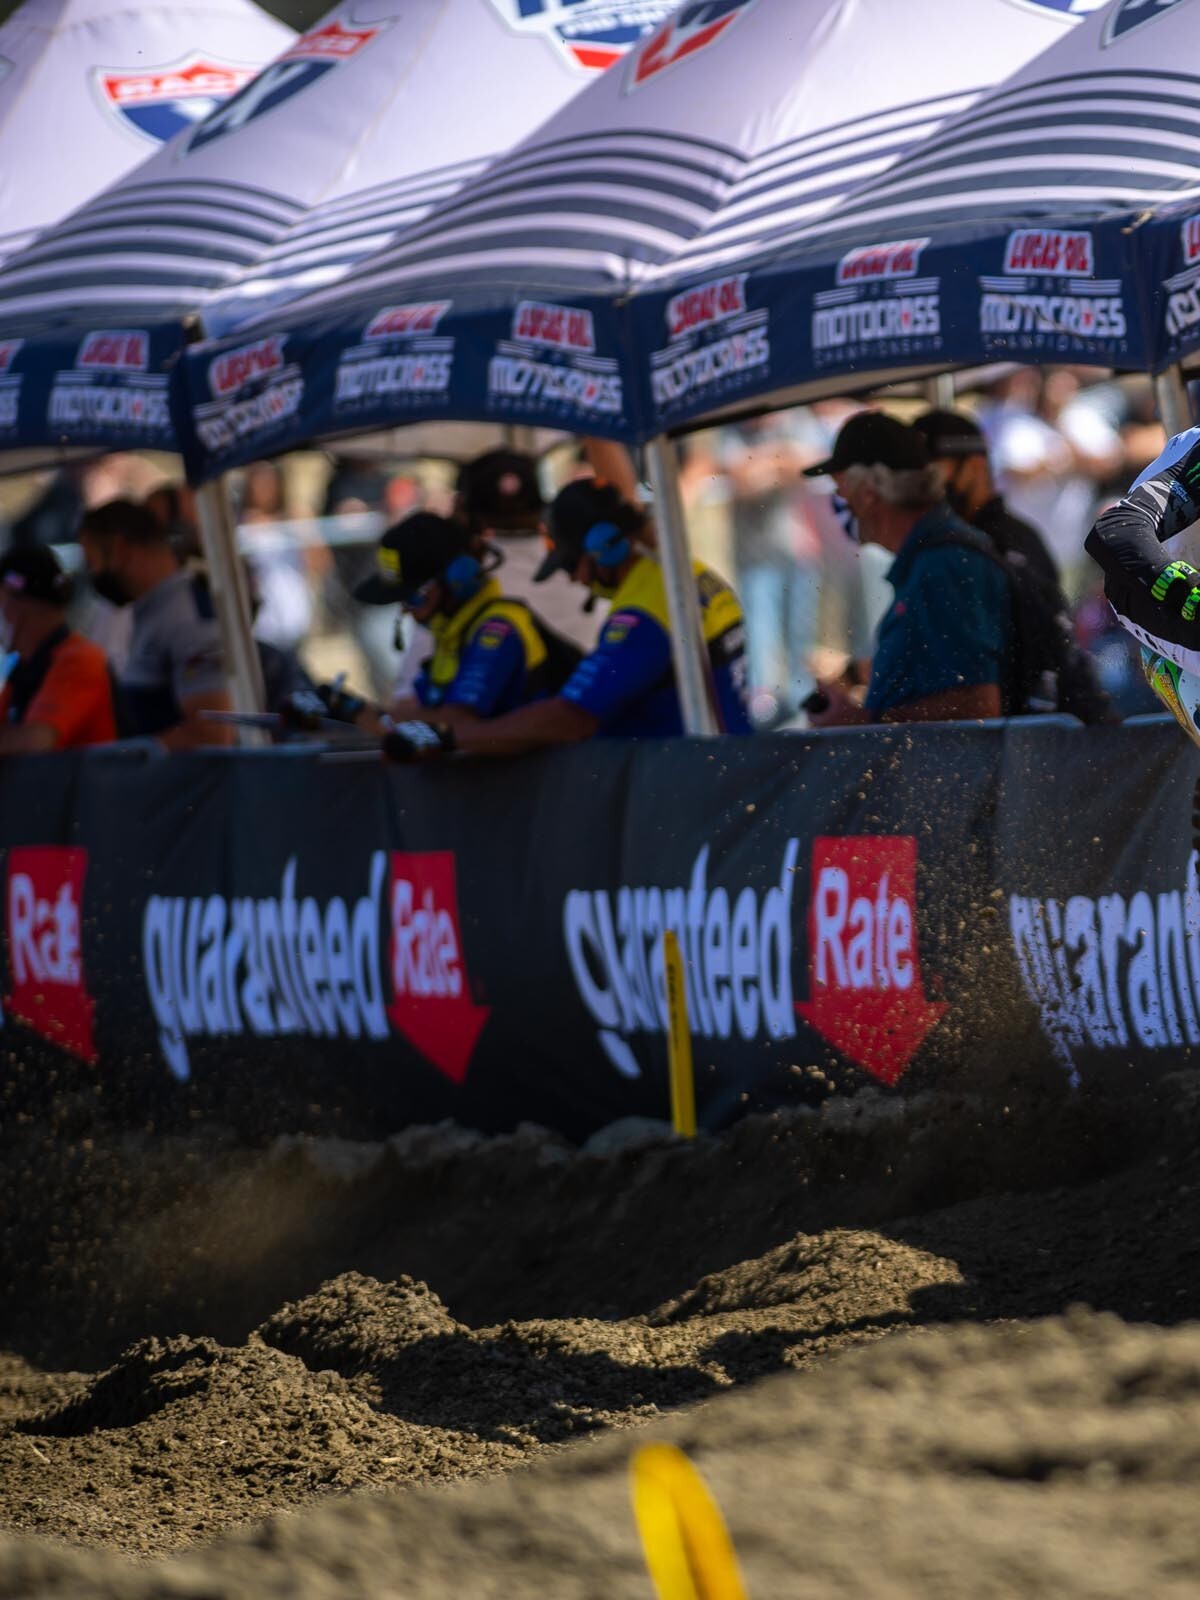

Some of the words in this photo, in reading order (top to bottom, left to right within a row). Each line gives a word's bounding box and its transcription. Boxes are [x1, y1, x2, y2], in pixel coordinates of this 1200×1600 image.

[1010, 234, 1061, 270] LUCAS
[812, 295, 940, 350] MOTOCROSS
[980, 294, 1127, 337] MOTOCROSS
[814, 867, 915, 990] Rate
